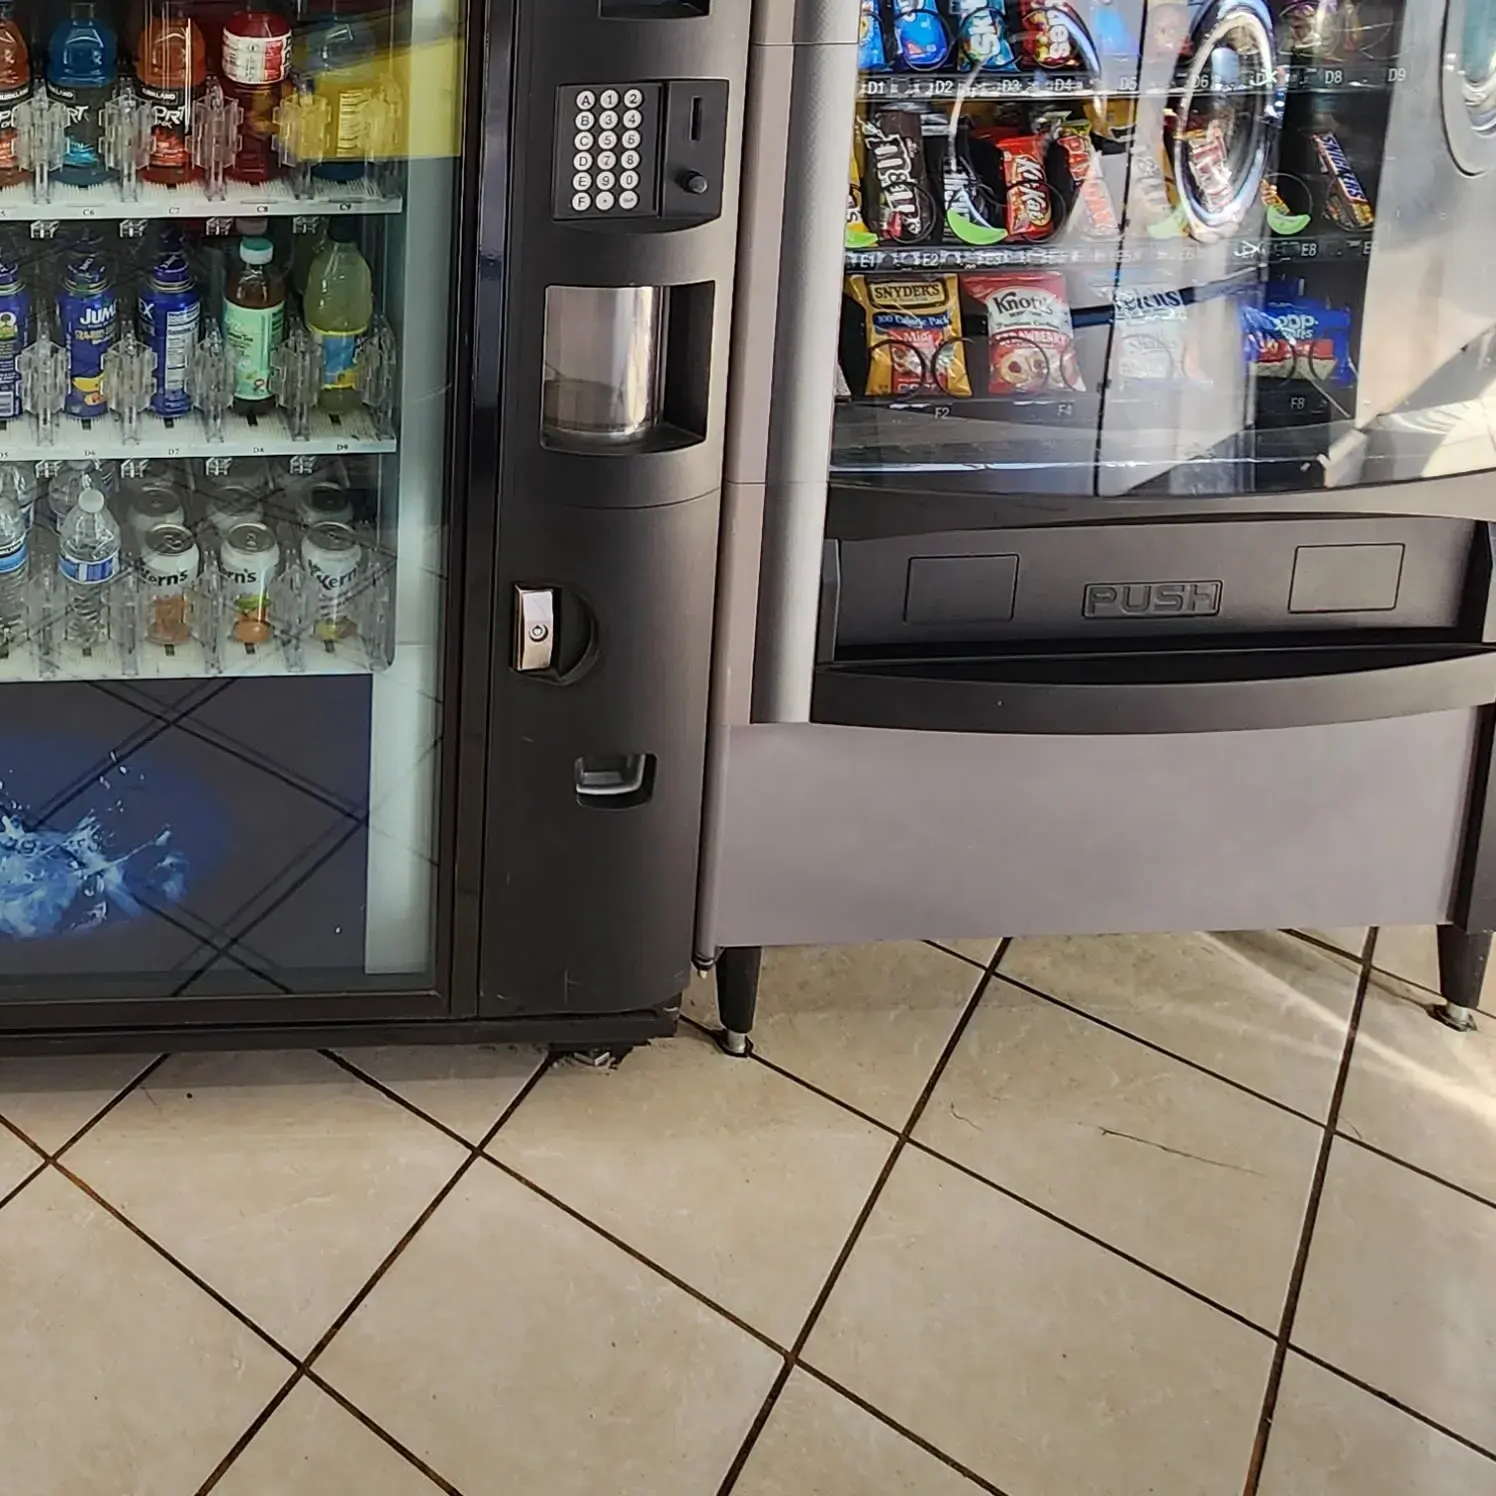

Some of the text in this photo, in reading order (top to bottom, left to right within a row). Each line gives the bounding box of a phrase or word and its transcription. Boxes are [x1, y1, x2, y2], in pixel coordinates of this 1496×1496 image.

[1193, 74, 1209, 87] D6
[1325, 70, 1342, 84] D8
[1388, 68, 1407, 82] D9
[868, 81, 884, 94] D1
[936, 81, 953, 94] D2
[581, 95, 591, 105] A
[630, 94, 637, 103] 2
[581, 114, 636, 126] B 3 4
[580, 134, 635, 146] C 5 6
[579, 155, 634, 166] D 7 8
[579, 175, 633, 186] E 9 0
[578, 197, 586, 206] F
[83, 208, 95, 217] C6
[169, 207, 180, 215] C7
[256, 205, 269, 213] C8
[1302, 244, 1317, 256] E8
[874, 283, 941, 300] SNYDER'S
[80, 304, 116, 325] JUM
[1291, 397, 1305, 410] F8
[935, 408, 949, 422] F2
[85, 449, 96, 457] D6
[336, 443, 349, 451] D9
[1088, 584, 1218, 615] PUSH
